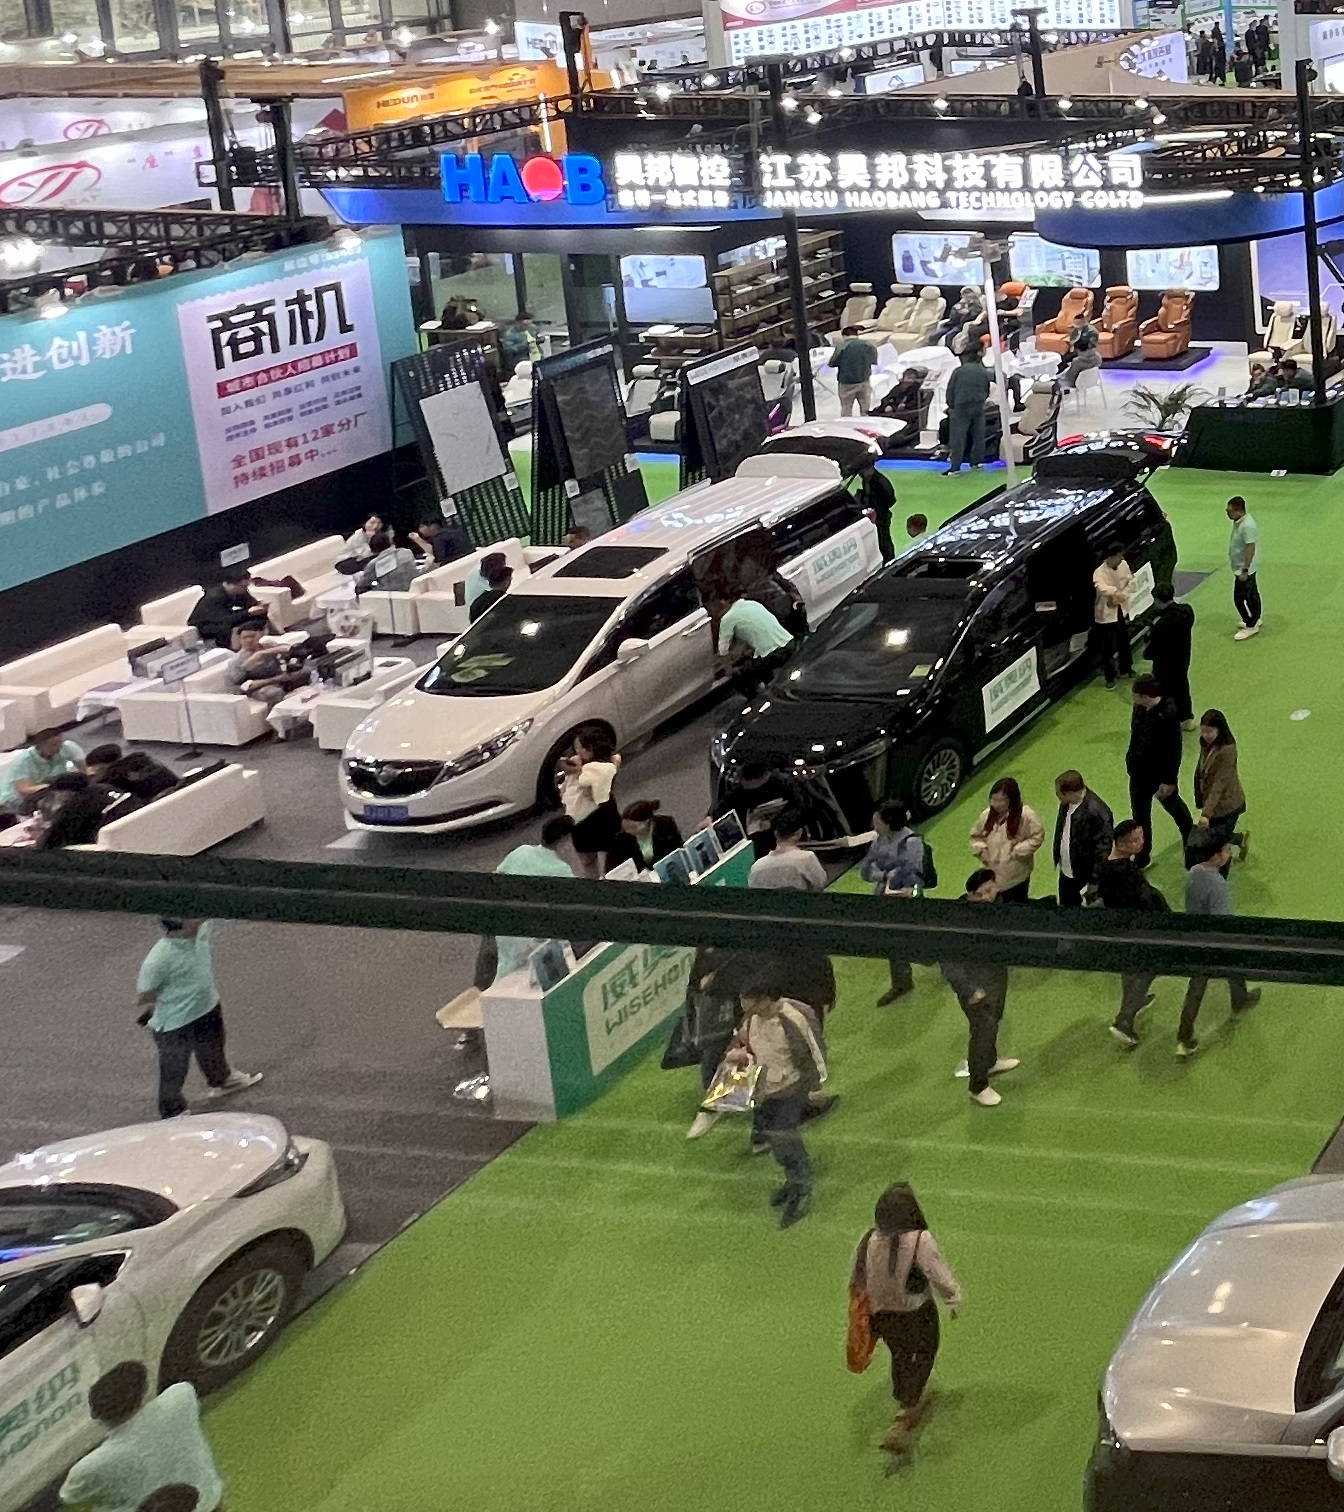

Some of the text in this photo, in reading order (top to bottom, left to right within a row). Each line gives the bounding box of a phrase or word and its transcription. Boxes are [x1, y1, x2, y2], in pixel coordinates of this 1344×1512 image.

[844, 190, 941, 209] HAOBANG
[946, 190, 1074, 209] TECHNOLOGY
[206, 280, 355, 371] 商机
